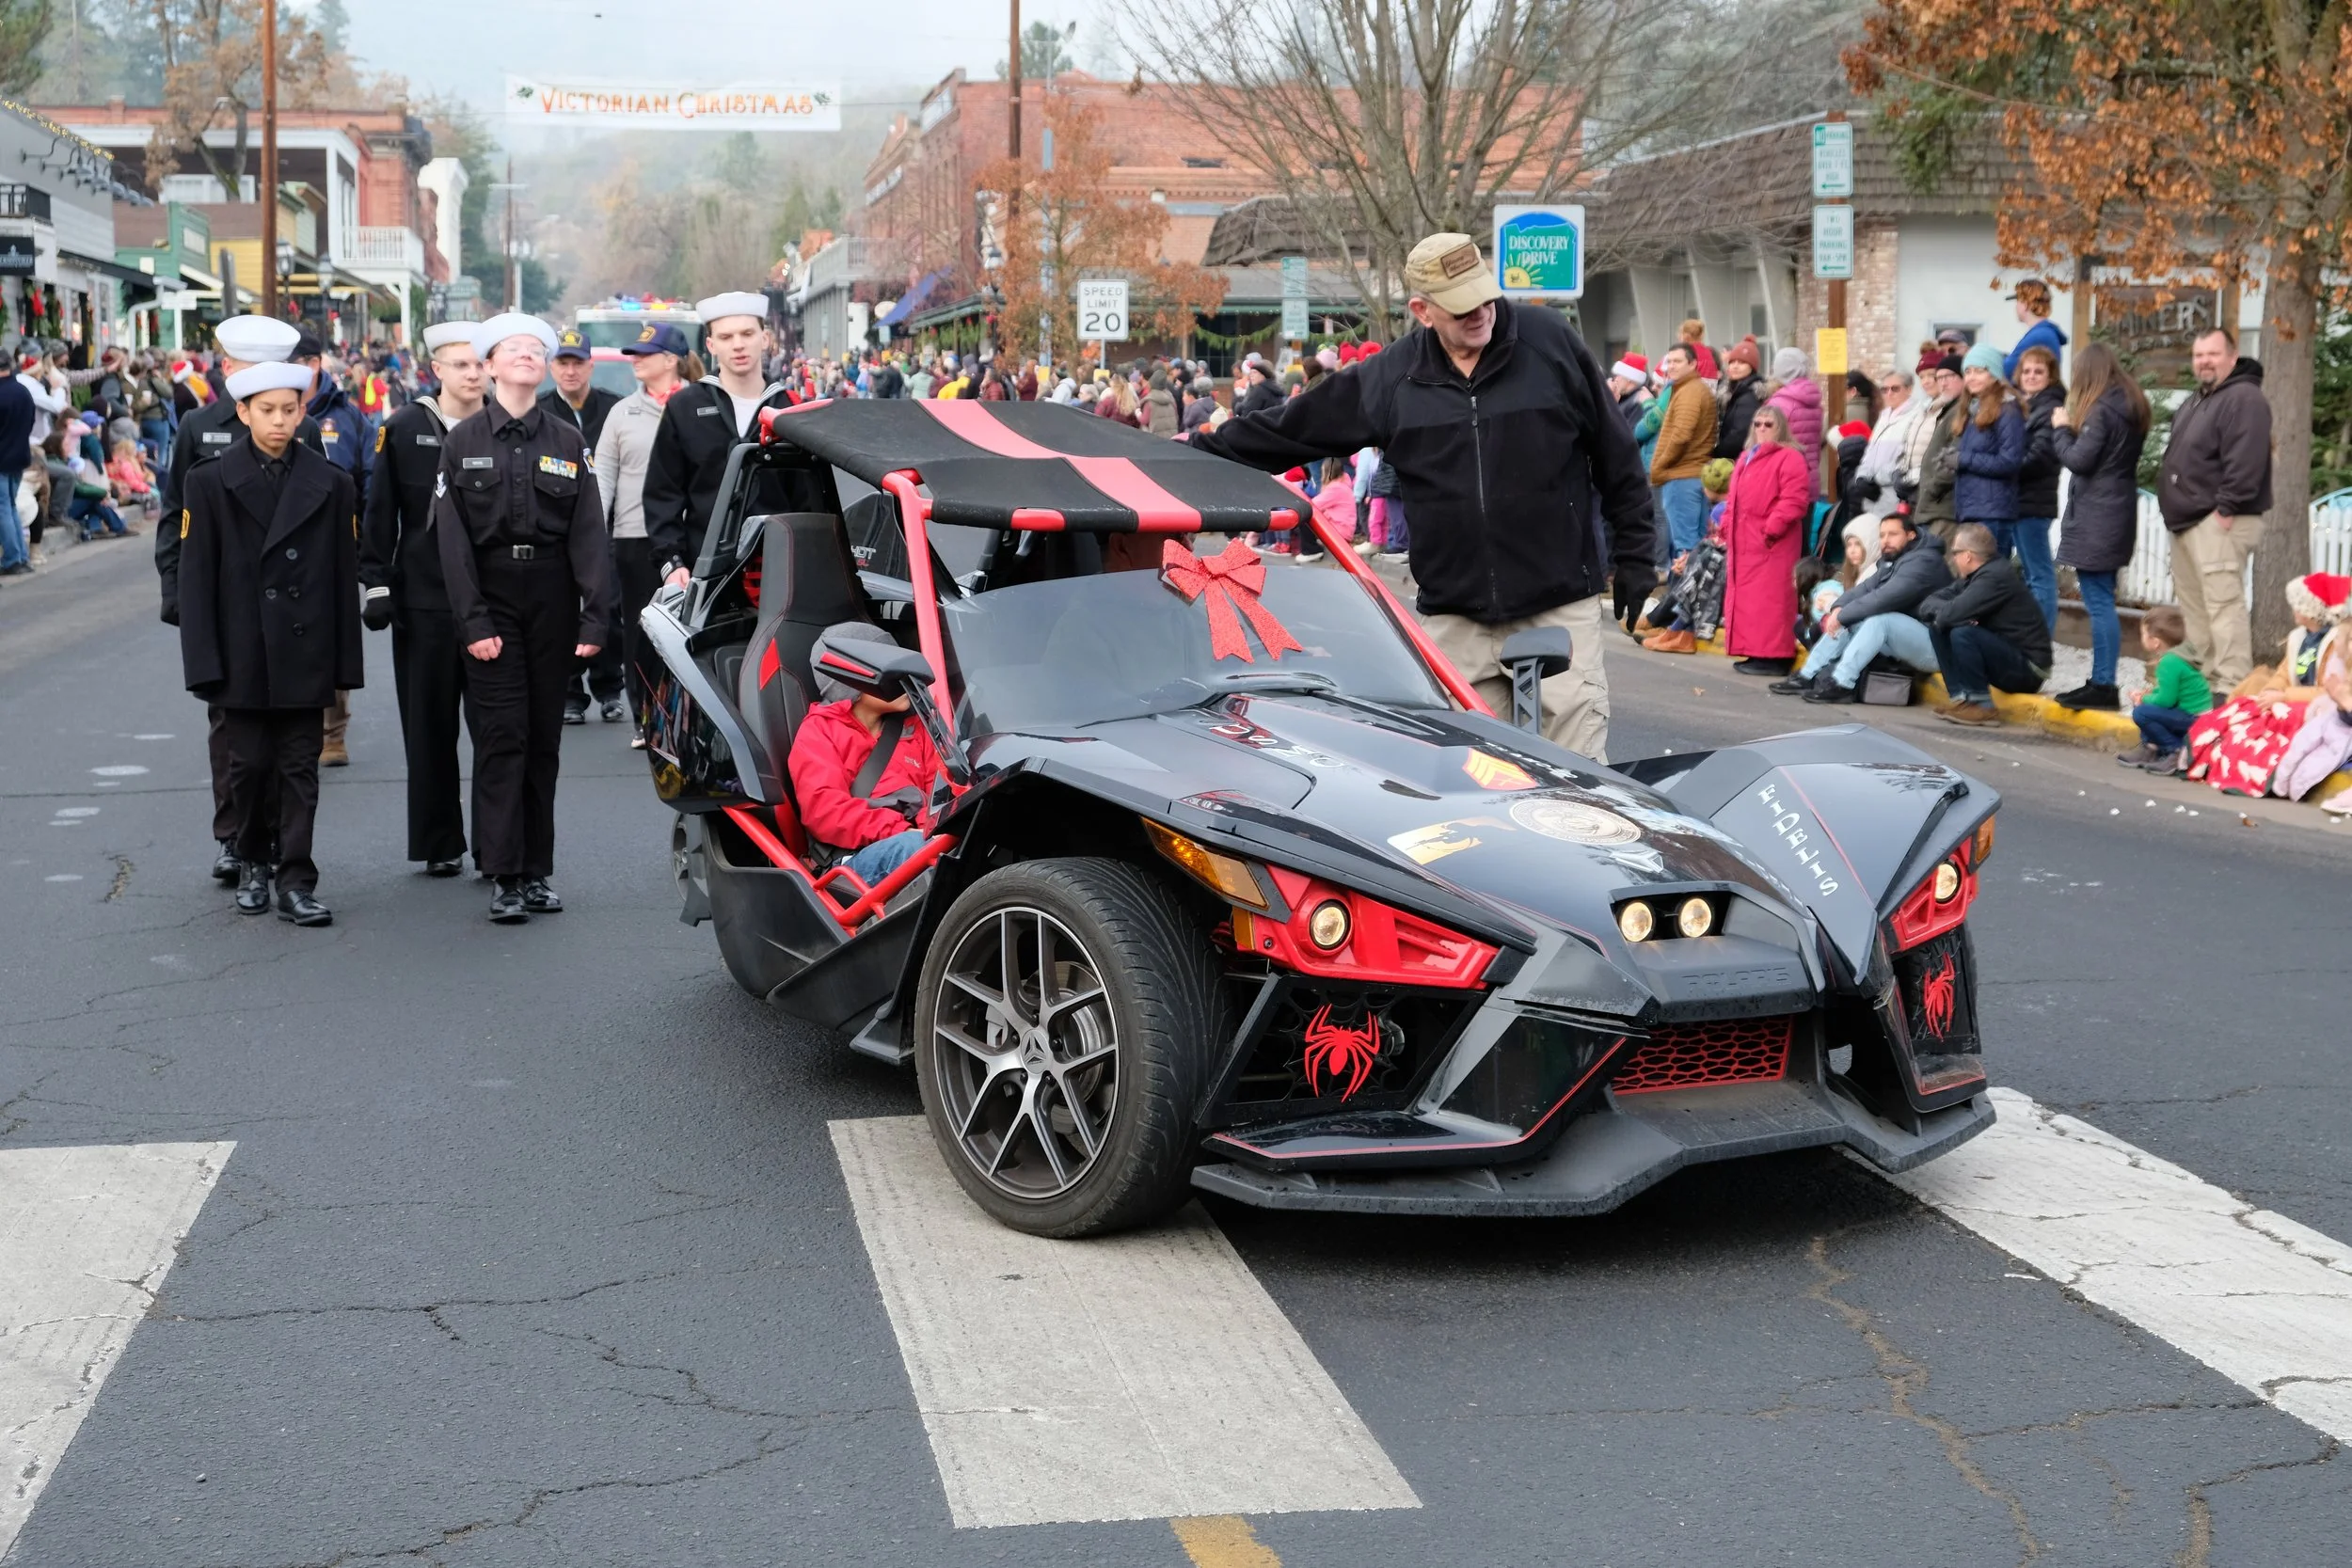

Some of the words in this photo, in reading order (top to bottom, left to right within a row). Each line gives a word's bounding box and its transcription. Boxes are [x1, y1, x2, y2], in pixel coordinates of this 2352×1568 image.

[540, 87, 669, 114] VICTORIAN
[676, 91, 814, 119] CHRISTMAS
[1826, 215, 1840, 224] TWO
[1823, 227, 1844, 237] HOUR
[1508, 234, 1569, 250] DISCOVERY
[1820, 240, 1849, 249] PARKING
[1521, 250, 1559, 265] DRIVE
[1083, 286, 1123, 296] SPEED
[1087, 299, 1118, 309] LIMIT
[1085, 312, 1120, 332] 20
[1757, 784, 1839, 896] FIDELIS
